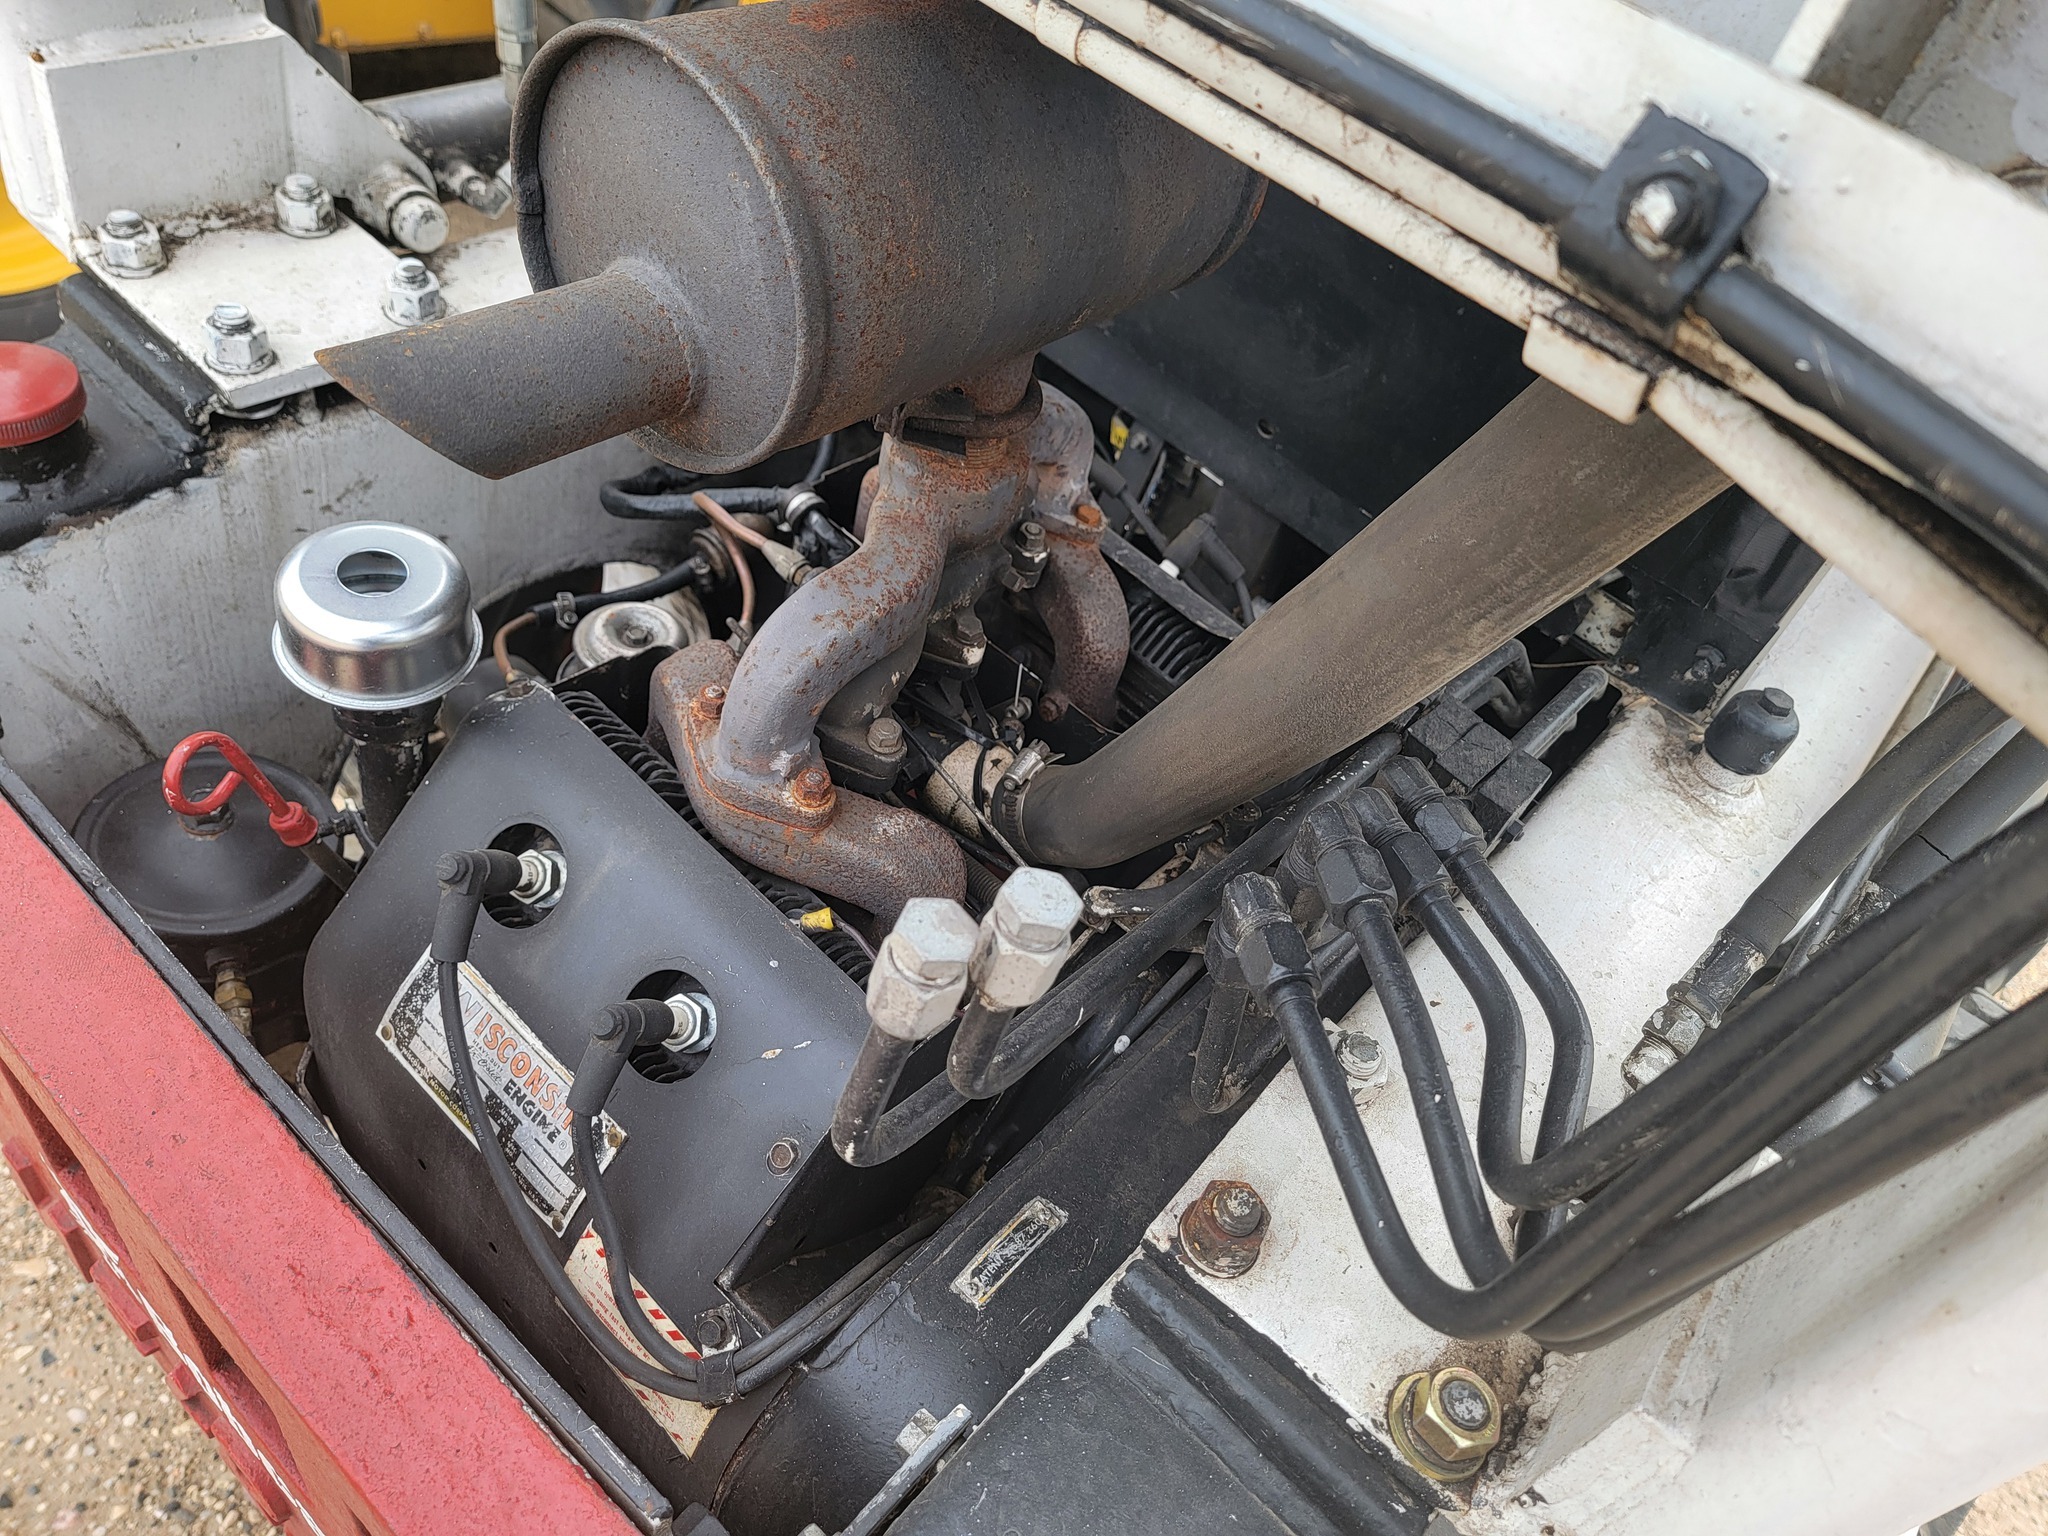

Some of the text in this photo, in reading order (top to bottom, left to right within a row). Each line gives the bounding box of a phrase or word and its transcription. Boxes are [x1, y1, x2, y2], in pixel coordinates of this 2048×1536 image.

[471, 1037, 504, 1074] HEAVY-DUTY
[451, 1061, 466, 1085] PLUG
[427, 1077, 450, 1102] MOTOR
[447, 1099, 475, 1131] CORPOR
[459, 1086, 476, 1116] SPARK
[501, 1078, 562, 1144] ENGINE
[472, 1121, 485, 1141] 7MM
[594, 1297, 610, 1314] using
[608, 1311, 619, 1325] fast
